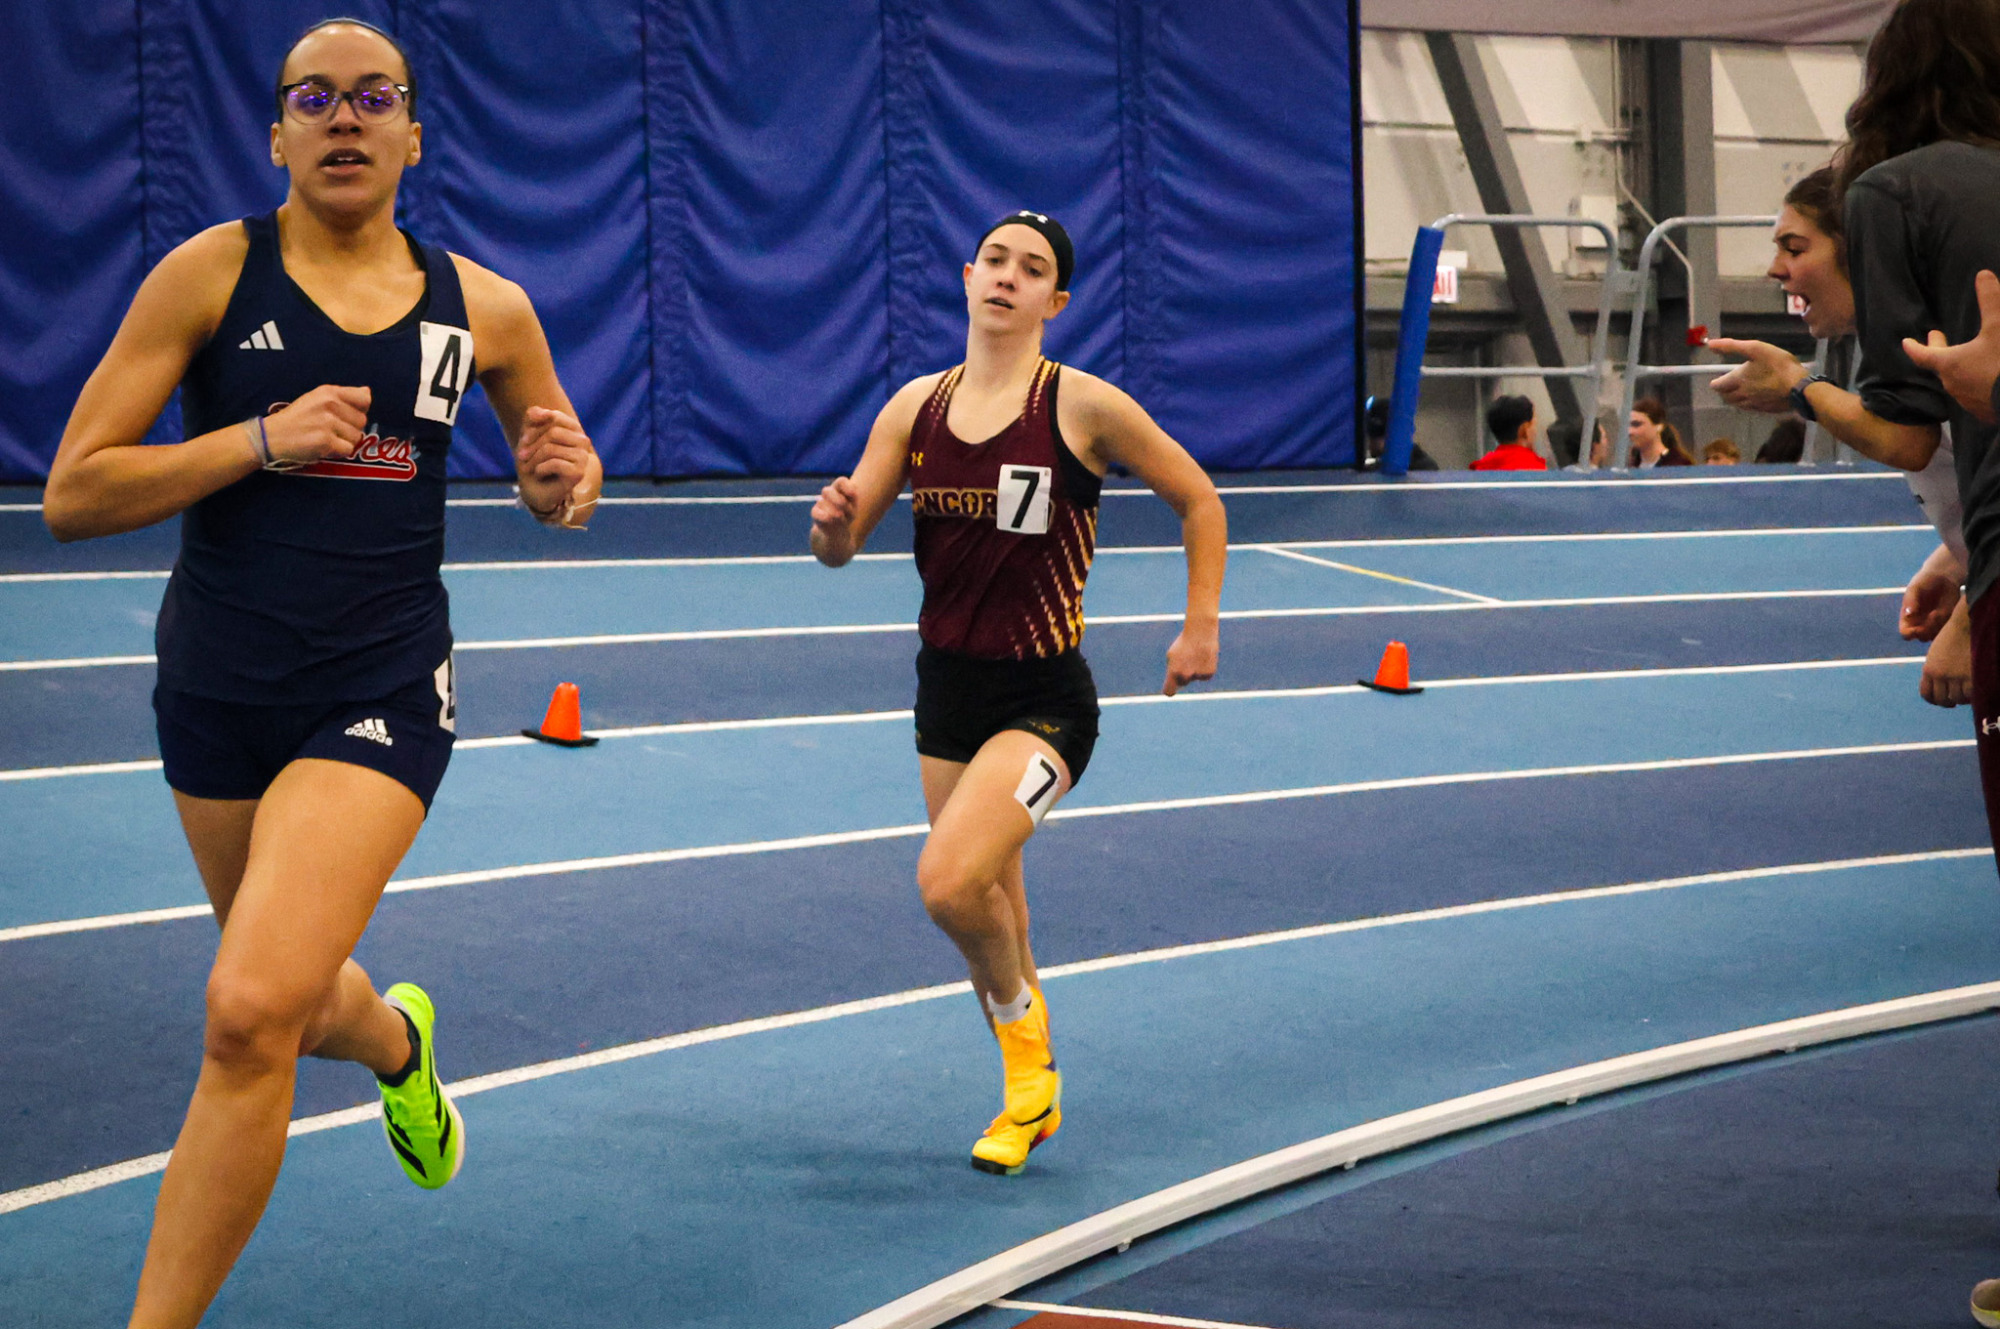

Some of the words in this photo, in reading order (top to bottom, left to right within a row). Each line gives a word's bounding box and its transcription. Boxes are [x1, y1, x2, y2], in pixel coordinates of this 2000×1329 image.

[430, 334, 461, 419] 4
[1011, 470, 1040, 529] 7
[344, 727, 394, 747] adidas
[1026, 758, 1057, 809] 7
